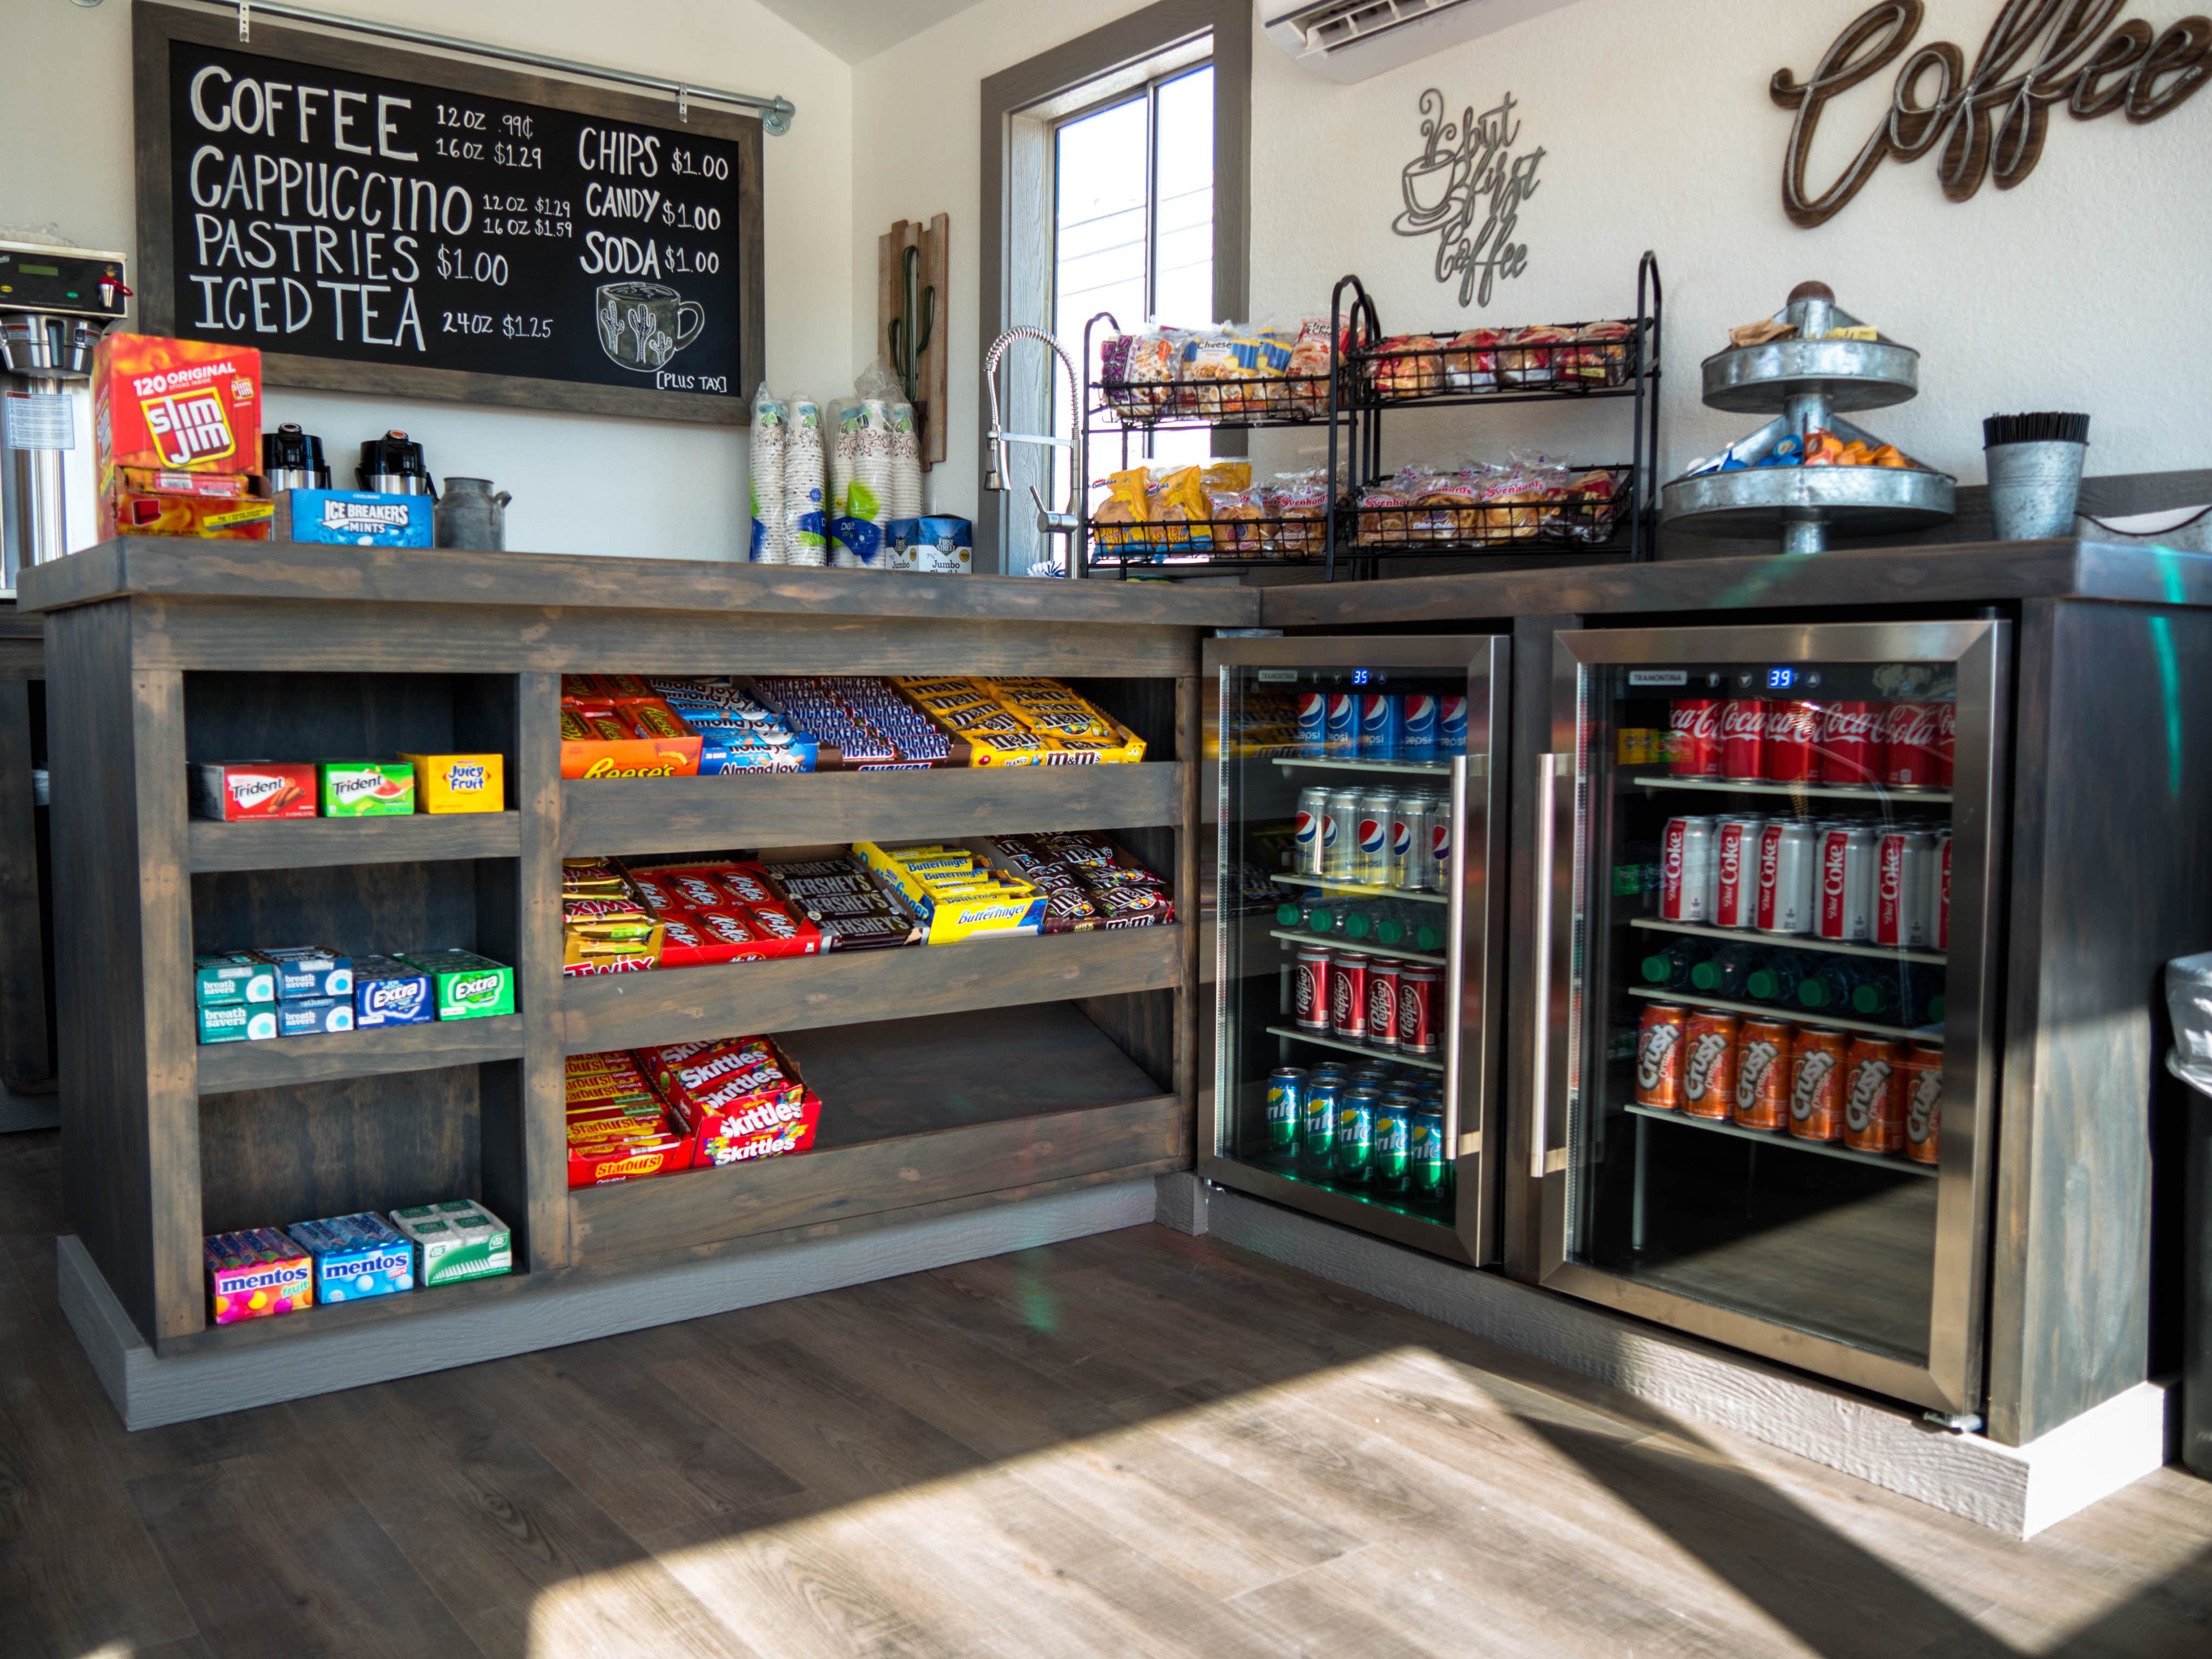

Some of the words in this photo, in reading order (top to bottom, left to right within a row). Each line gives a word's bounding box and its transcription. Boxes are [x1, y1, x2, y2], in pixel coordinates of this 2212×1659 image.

[191, 65, 418, 161] COFFEE
[1770, 0, 2212, 228] Coffee
[578, 127, 661, 178] CHIPS
[672, 147, 729, 180] $1.00
[586, 183, 660, 223] CANDY
[662, 200, 721, 231] $1.00
[196, 214, 420, 283] PASTRIES
[437, 243, 509, 286] $1.00
[580, 231, 661, 280] SODA
[665, 244, 720, 275] $1.00
[1435, 215, 1528, 307] Coffee
[190, 274, 312, 334] ICED
[318, 280, 427, 352] TEA
[503, 313, 554, 339] $1.25
[1198, 341, 1231, 349] Cheese
[133, 376, 166, 396] 120
[166, 361, 236, 384] ORIGINAL
[325, 500, 345, 519] ICE
[348, 503, 409, 527] BREAKERS
[348, 522, 385, 534] MINTS
[892, 560, 909, 569] Jumbo
[933, 560, 960, 569] Jumbo
[1354, 671, 1367, 684] 35
[1634, 674, 1682, 682] TRAMONTINA
[1770, 670, 1790, 686] 39
[853, 704, 913, 718] SNICKERS
[866, 713, 925, 727] SNICKERS
[878, 725, 935, 737] SNICKERS
[889, 734, 949, 748] SNICKERS
[1298, 730, 1320, 741] epsi
[1328, 732, 1348, 743] epsi
[1363, 734, 1384, 745] epsi
[1405, 734, 1432, 746] epsi
[448, 765, 483, 778] Juicy
[232, 778, 284, 800] Trident
[332, 775, 382, 796] Trident
[451, 778, 484, 791] Fruit
[907, 859, 969, 873] Butterfinger
[1665, 831, 1682, 879] Coke
[1721, 837, 1739, 885] Coke
[1761, 838, 1777, 887] Coke
[1825, 845, 1844, 896] Coke
[1881, 848, 1901, 900] Coke
[785, 873, 872, 897] HERSHEY'S
[799, 893, 889, 914] HERSHEY'S
[957, 904, 1028, 926] Butterfinger
[204, 980, 235, 989] breath
[285, 974, 315, 983] breath
[285, 981, 315, 989] savers
[455, 975, 497, 1000] Extra
[374, 983, 418, 1008] Extra
[205, 1007, 247, 1020] breath
[206, 1017, 246, 1028] savers
[285, 1011, 315, 1020] breath
[285, 1017, 315, 1026] savers
[1638, 1024, 1679, 1090] Crush
[1684, 1033, 1728, 1101] Crush
[680, 1050, 768, 1089] Skittles
[1705, 1053, 1724, 1089] Orange
[1736, 1041, 1778, 1111] Crush
[1756, 1062, 1774, 1099] Orange
[1791, 1050, 1835, 1122] Crush
[1846, 1059, 1892, 1132] Crush
[569, 1118, 634, 1135] Starburst
[715, 1137, 795, 1166] Skittles
[597, 1155, 662, 1177] Starburst
[325, 1255, 408, 1278] mentos
[222, 1267, 308, 1293] mentos
[281, 1280, 308, 1299] fruit
